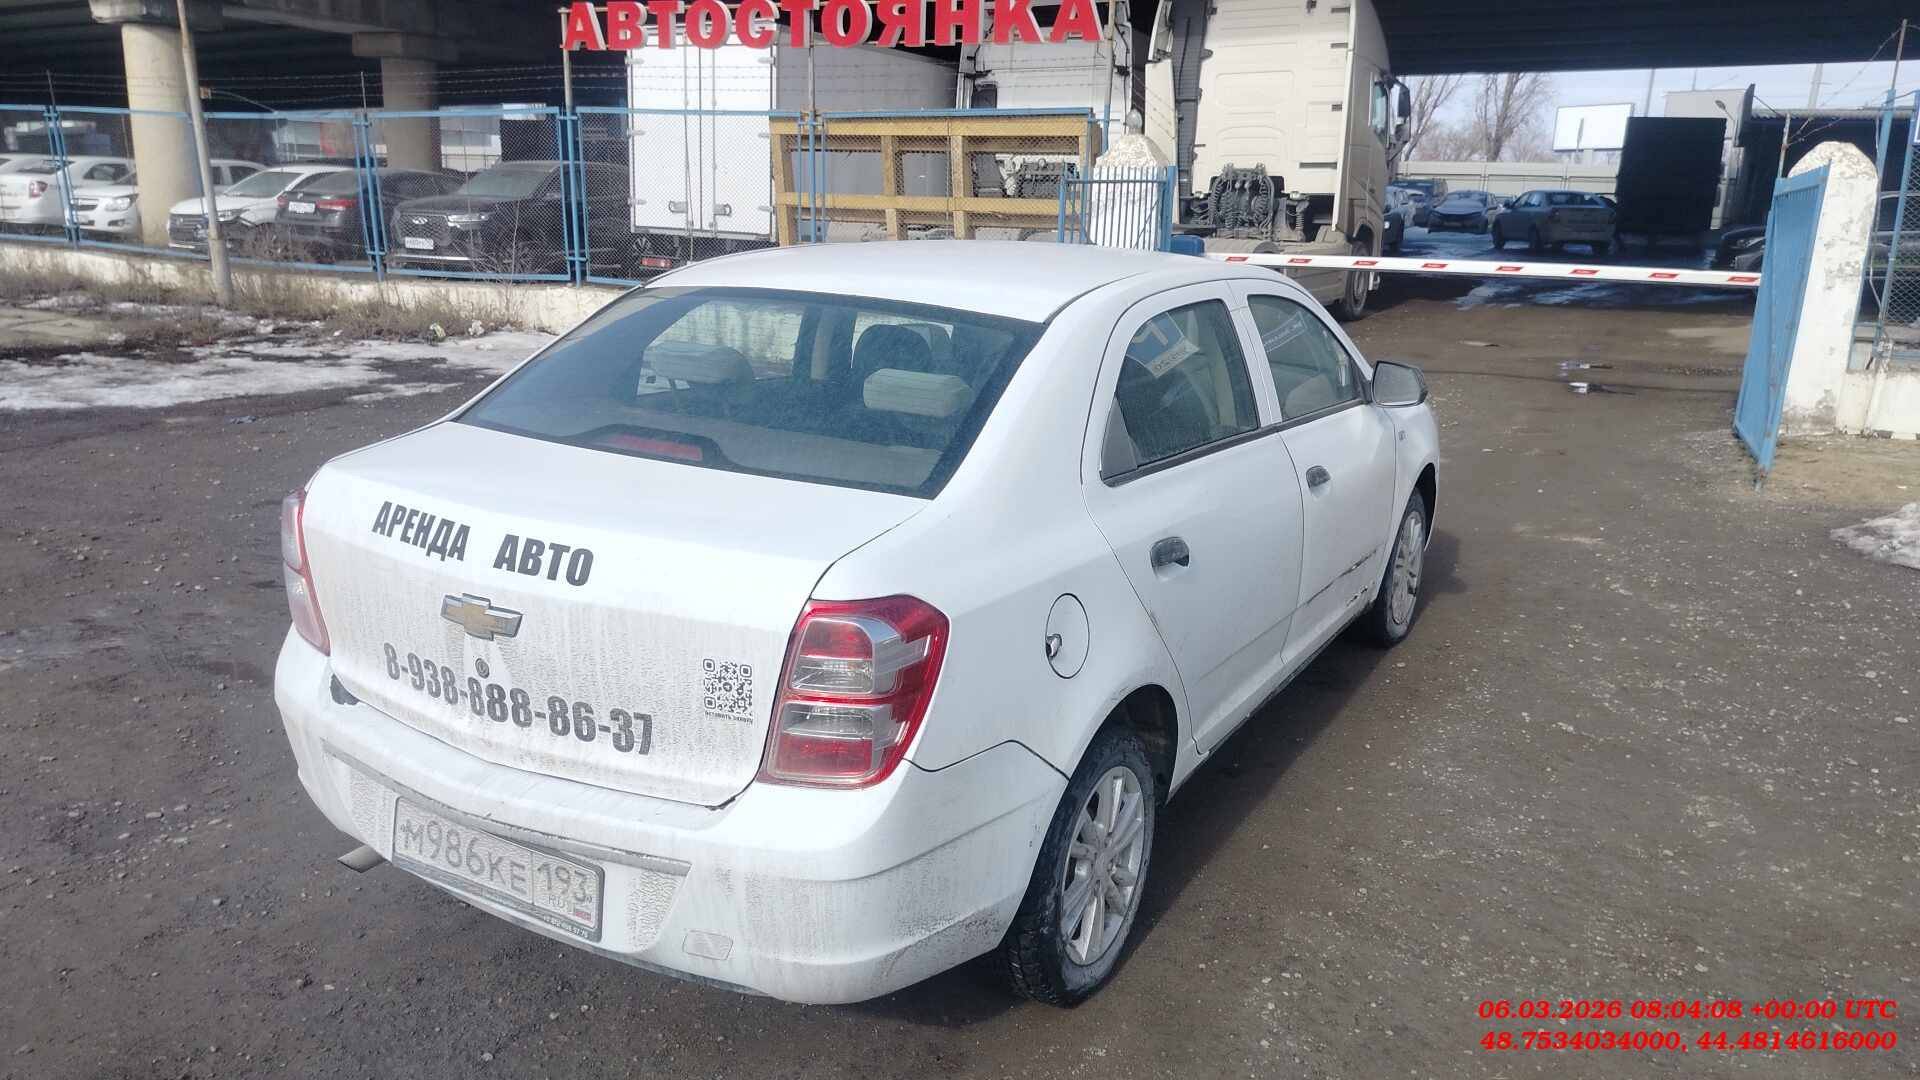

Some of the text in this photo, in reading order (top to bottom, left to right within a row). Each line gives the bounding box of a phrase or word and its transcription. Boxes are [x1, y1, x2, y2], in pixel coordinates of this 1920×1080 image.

[564, 0, 1105, 50] АВТОСТОЯНКА
[371, 500, 594, 587] АРЕНДА АВТО
[383, 642, 653, 755] 8-938-888-86-37
